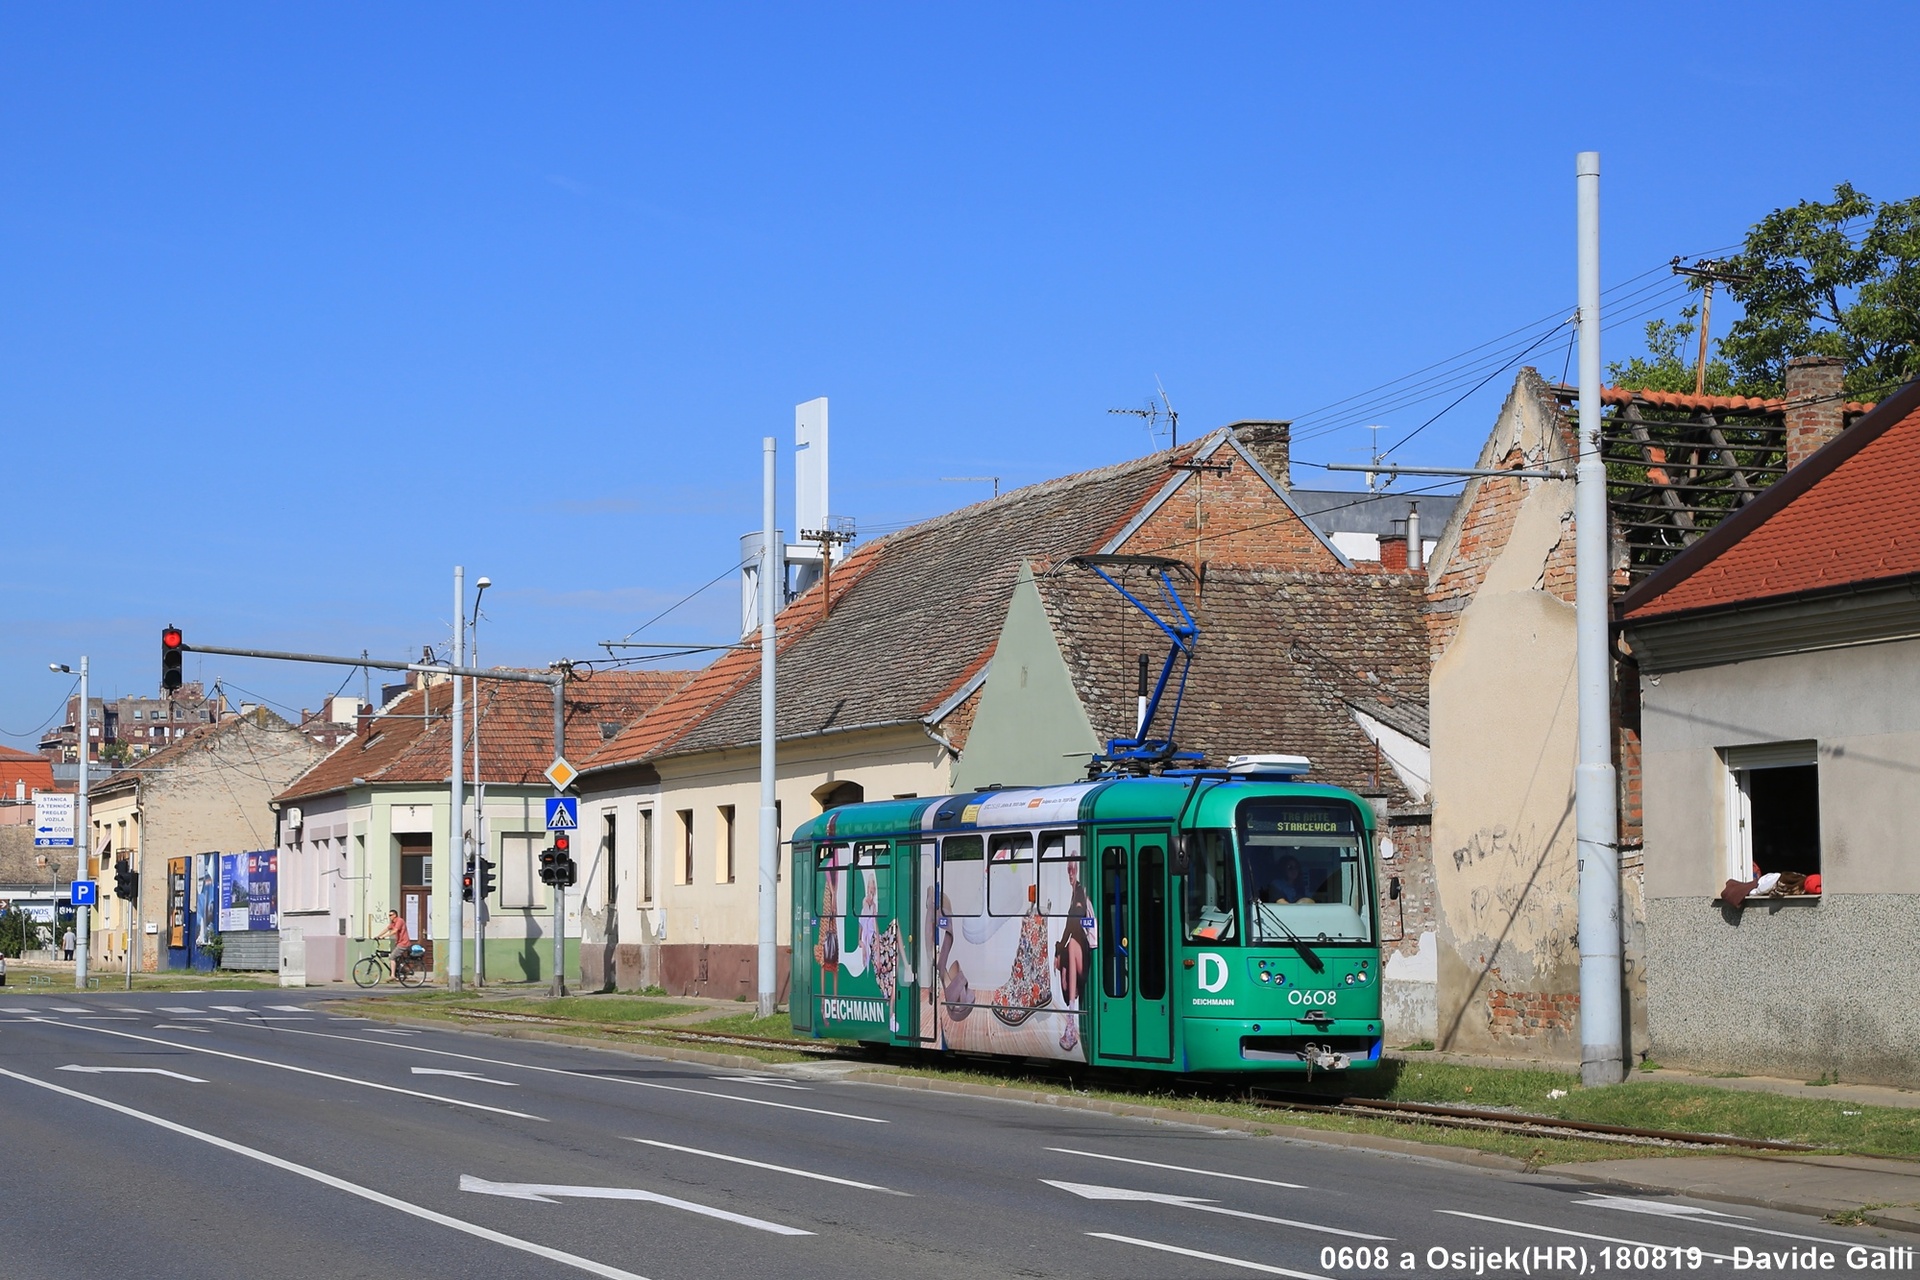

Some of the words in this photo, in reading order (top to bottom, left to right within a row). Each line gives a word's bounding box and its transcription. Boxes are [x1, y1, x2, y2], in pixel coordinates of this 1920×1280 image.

[78, 886, 88, 900] P
[1198, 952, 1229, 993] D
[1192, 998, 1234, 1006] DEICHMANN
[1287, 989, 1337, 1005] 0608
[824, 999, 885, 1022] DEICHMANN
